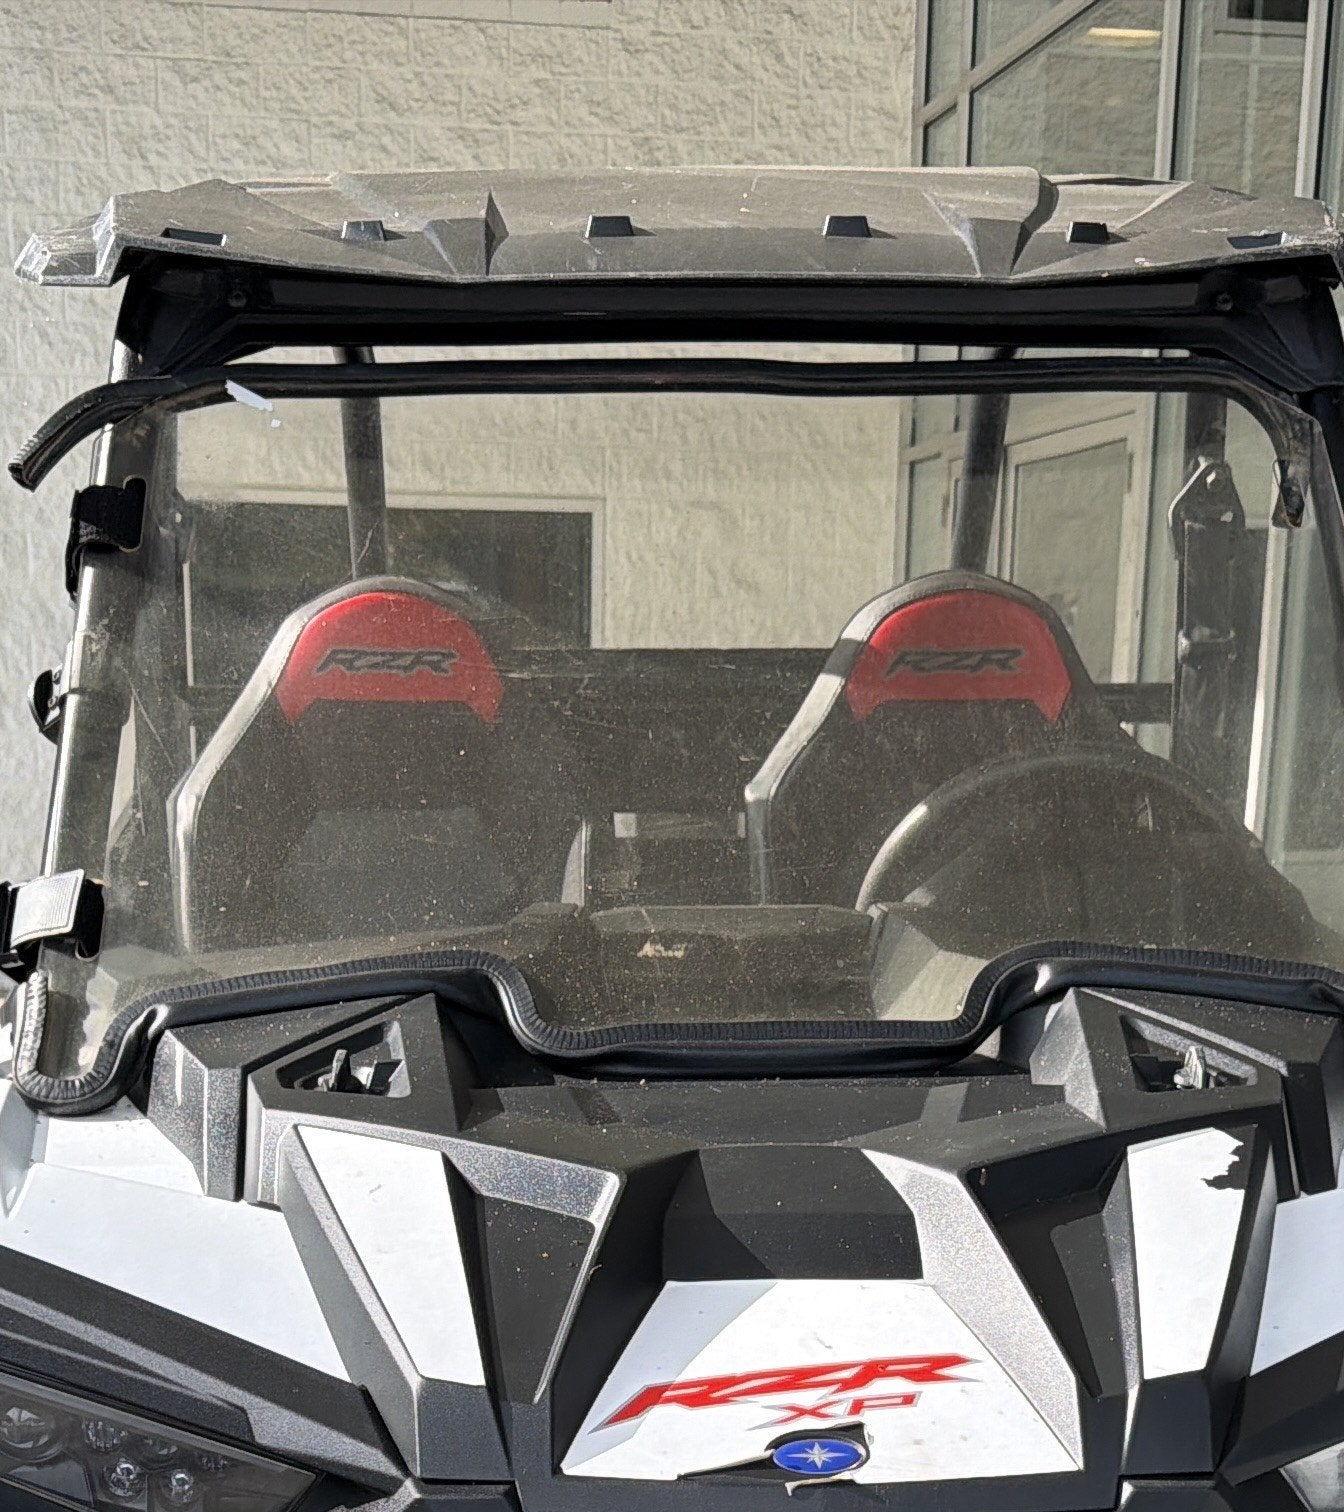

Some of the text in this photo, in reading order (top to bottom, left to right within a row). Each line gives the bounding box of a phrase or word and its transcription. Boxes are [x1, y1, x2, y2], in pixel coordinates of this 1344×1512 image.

[314, 646, 459, 676] RZR
[588, 1352, 982, 1434] RZR
[747, 1391, 924, 1431] XP
